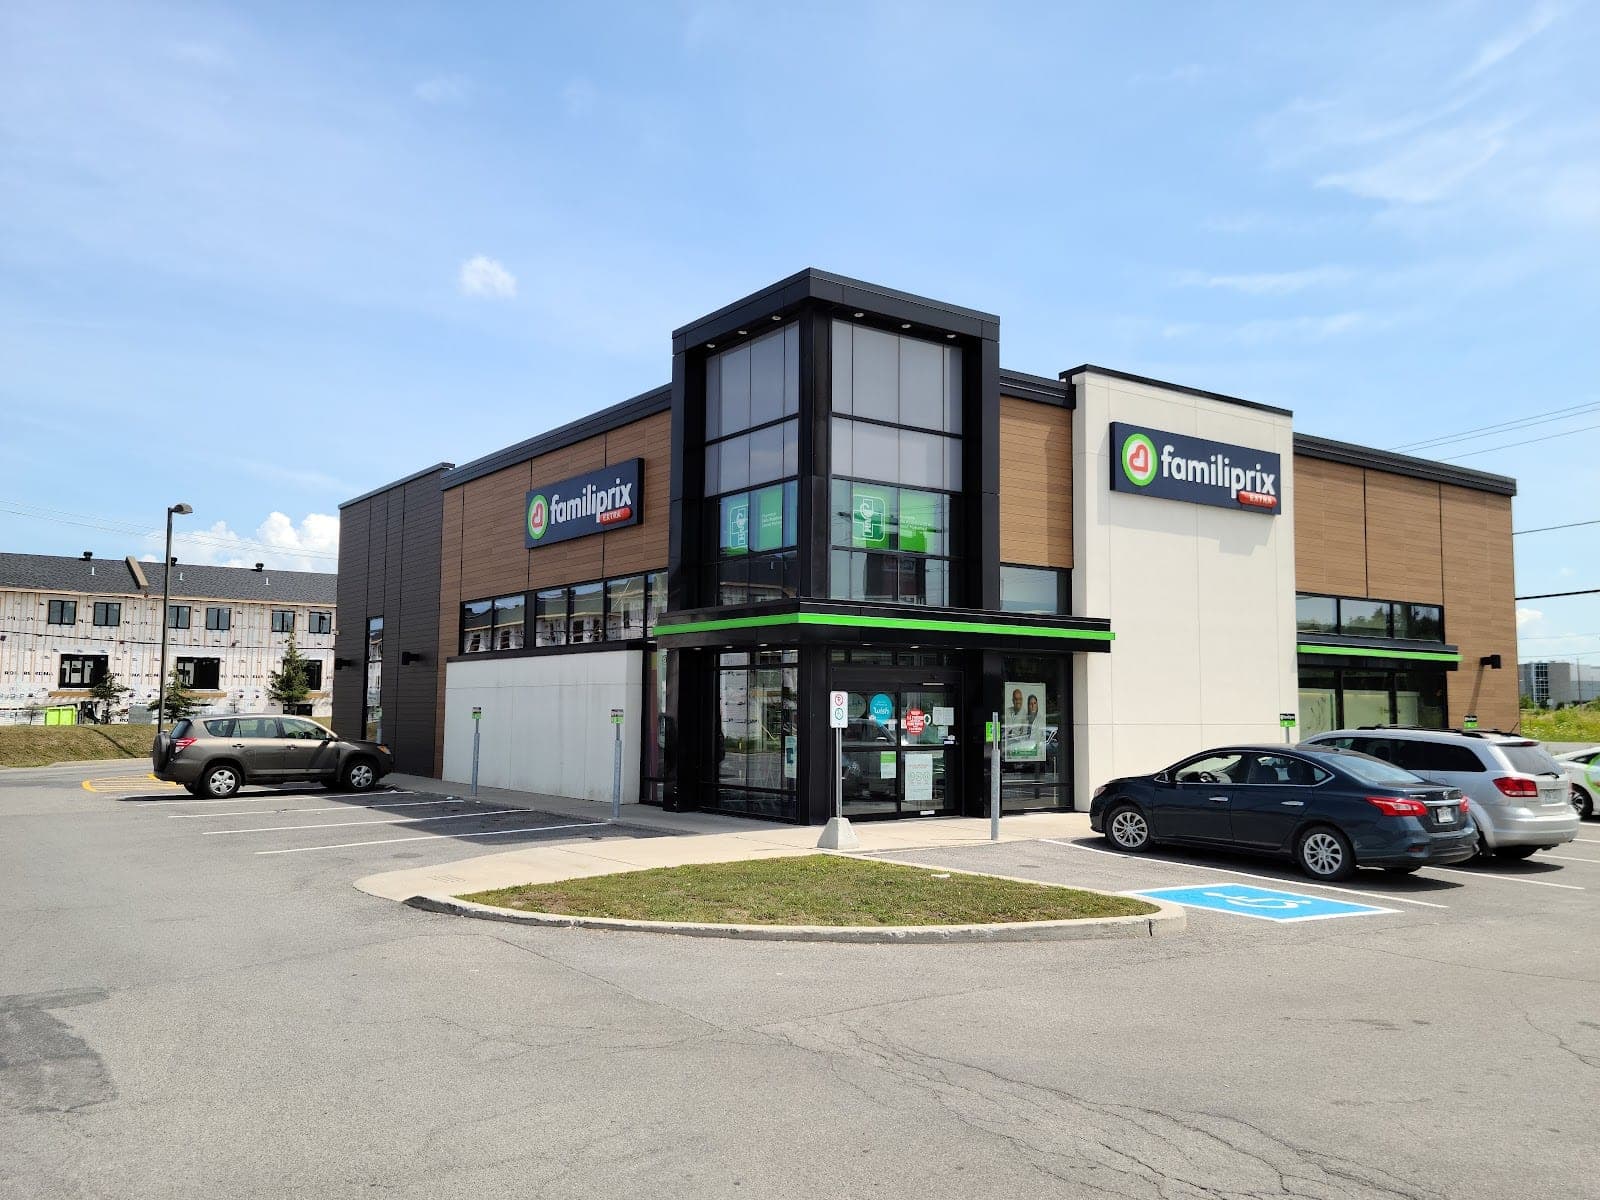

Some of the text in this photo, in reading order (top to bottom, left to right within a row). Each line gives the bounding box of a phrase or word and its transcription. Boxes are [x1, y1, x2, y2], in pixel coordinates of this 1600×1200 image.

[1160, 444, 1276, 499] familiprix
[549, 477, 632, 525] familiprix
[602, 510, 621, 522] EXTRA
